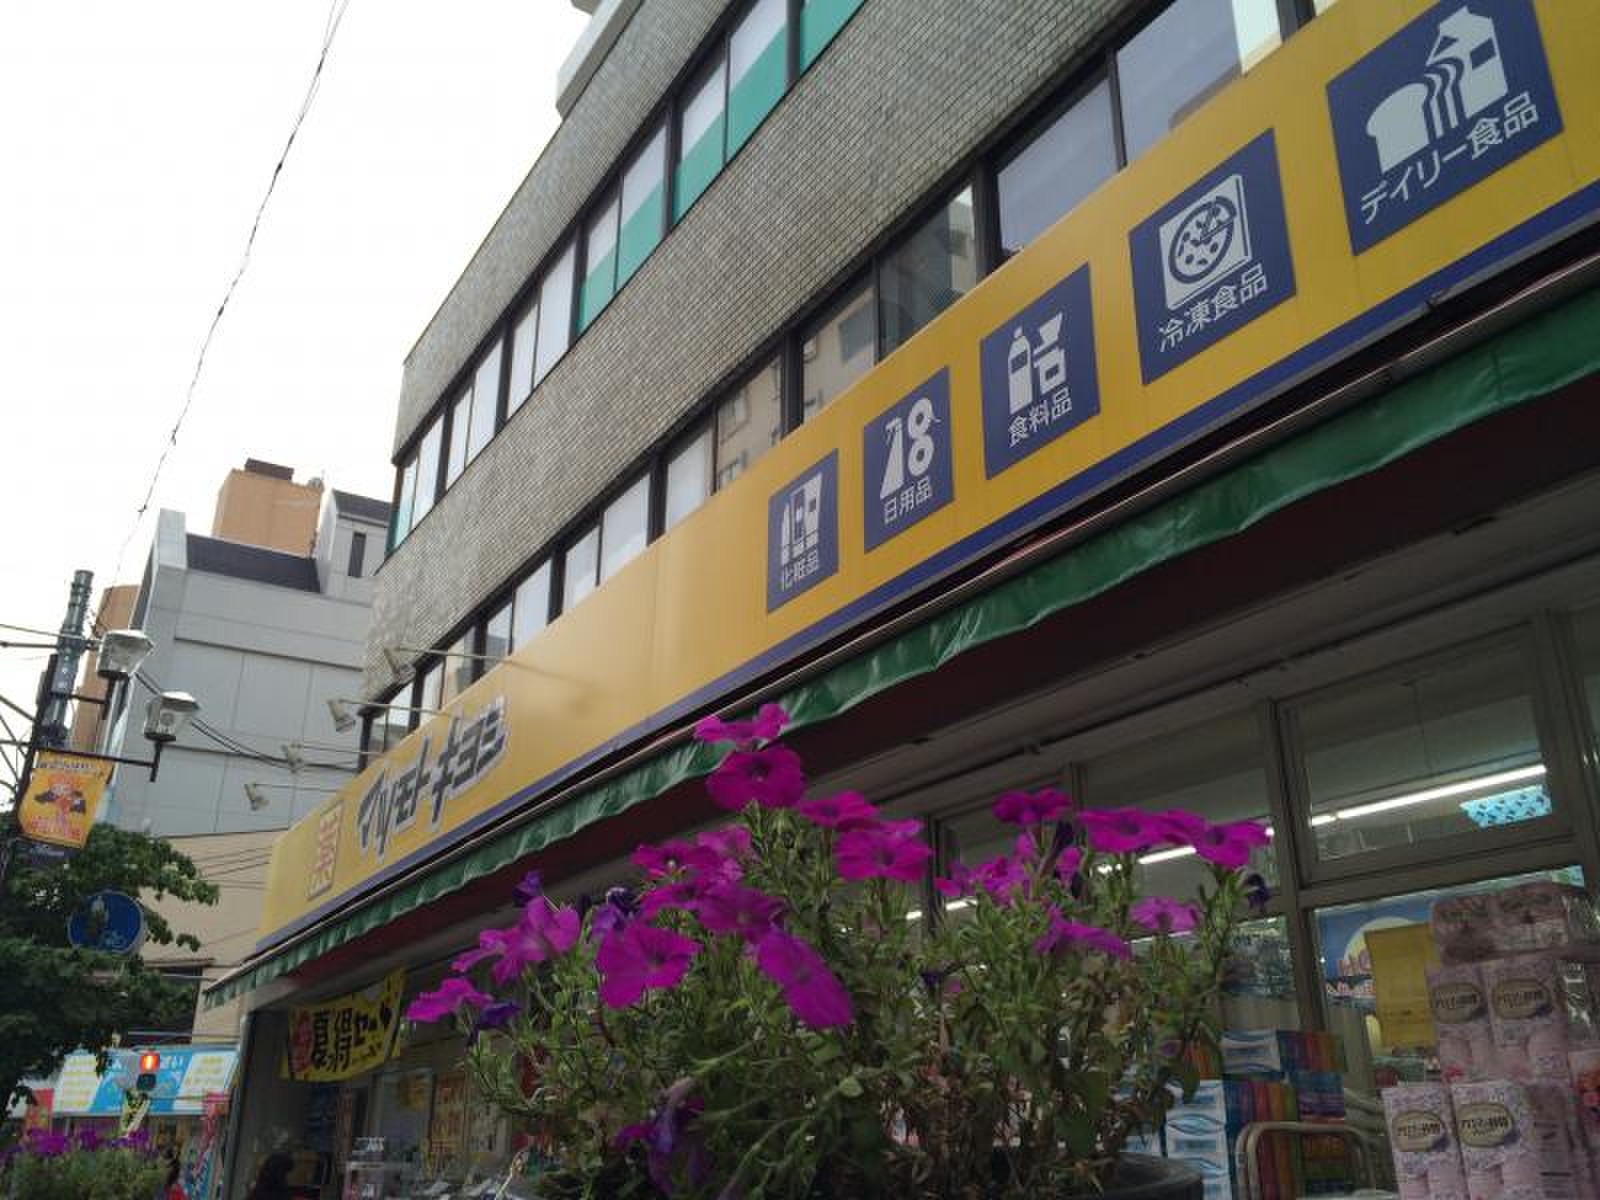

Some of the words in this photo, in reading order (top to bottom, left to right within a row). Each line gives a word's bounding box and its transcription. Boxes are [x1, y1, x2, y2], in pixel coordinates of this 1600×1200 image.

[1361, 91, 1539, 225] デイリー食品
[1008, 386, 1073, 448] 食料品
[884, 475, 933, 525] 日用品
[357, 696, 505, 863] マツモトキヨシ
